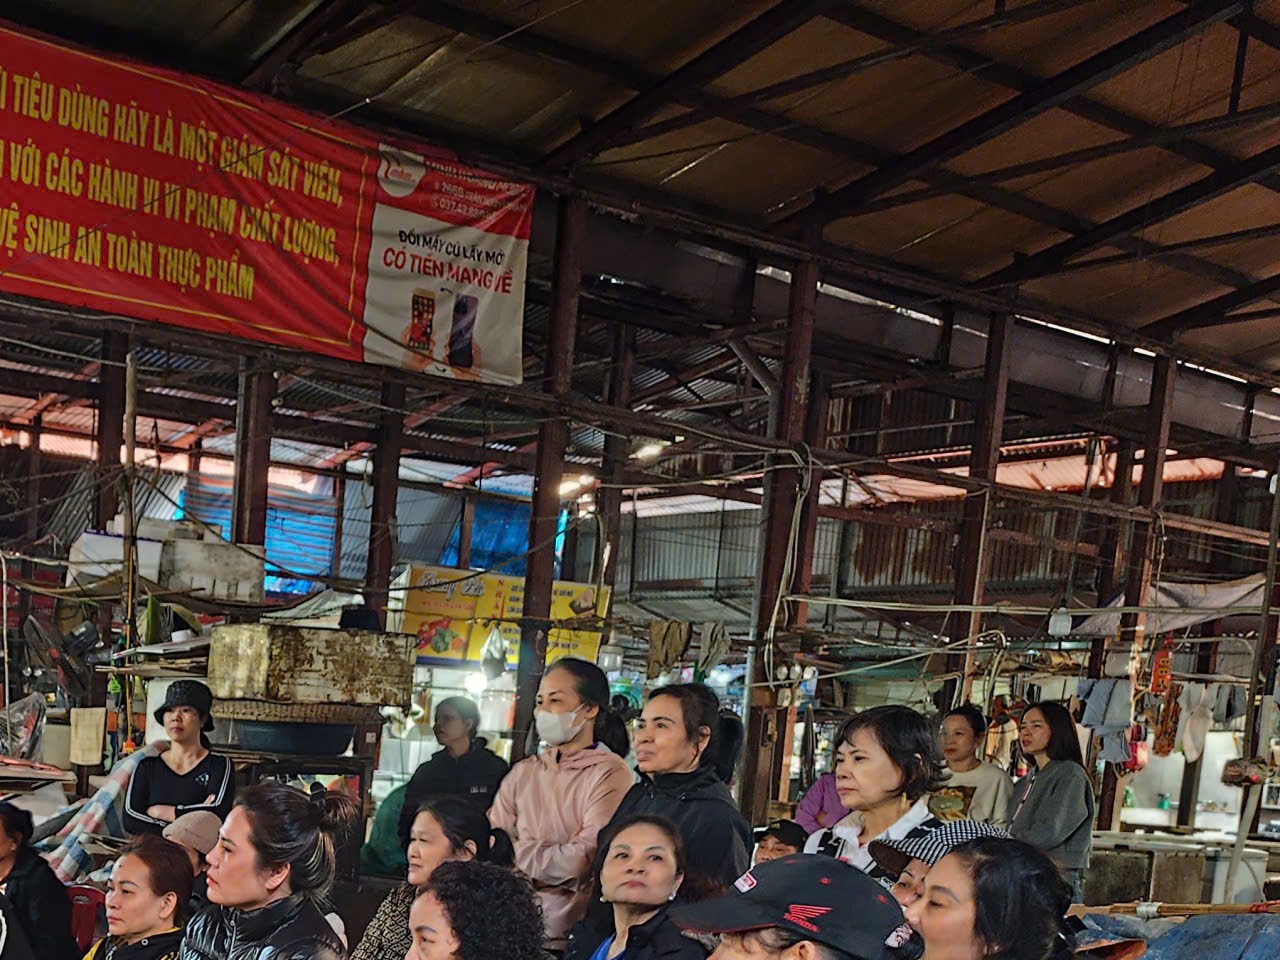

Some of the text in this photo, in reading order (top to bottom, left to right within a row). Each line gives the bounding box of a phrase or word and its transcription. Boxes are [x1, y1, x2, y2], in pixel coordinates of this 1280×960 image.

[13, 71, 54, 122] TIÊU
[57, 84, 110, 138] DÙNG
[114, 101, 150, 148] HÃY
[153, 110, 174, 155] LÀ
[179, 121, 218, 172] MỘT
[219, 134, 264, 181] GIÁM
[268, 147, 300, 192] SÁT
[303, 160, 343, 208] VIÊN,
[10, 138, 40, 187] VỚI
[46, 148, 84, 197] CÁC
[88, 159, 138, 210] HÀNH
[143, 177, 160, 216] VI
[164, 182, 181, 221] VI
[185, 188, 237, 238] PHẠM
[239, 199, 281, 244] CHẤT
[282, 215, 340, 267] LƯỢNG,
[422, 234, 446, 253] MÁY
[23, 214, 70, 260] SINH
[73, 226, 102, 267] AN
[106, 231, 153, 278] TOÀN
[158, 245, 201, 293] THỰC
[205, 249, 255, 300] PHẨM
[383, 245, 407, 270] CÓ
[447, 261, 494, 289] MANG
